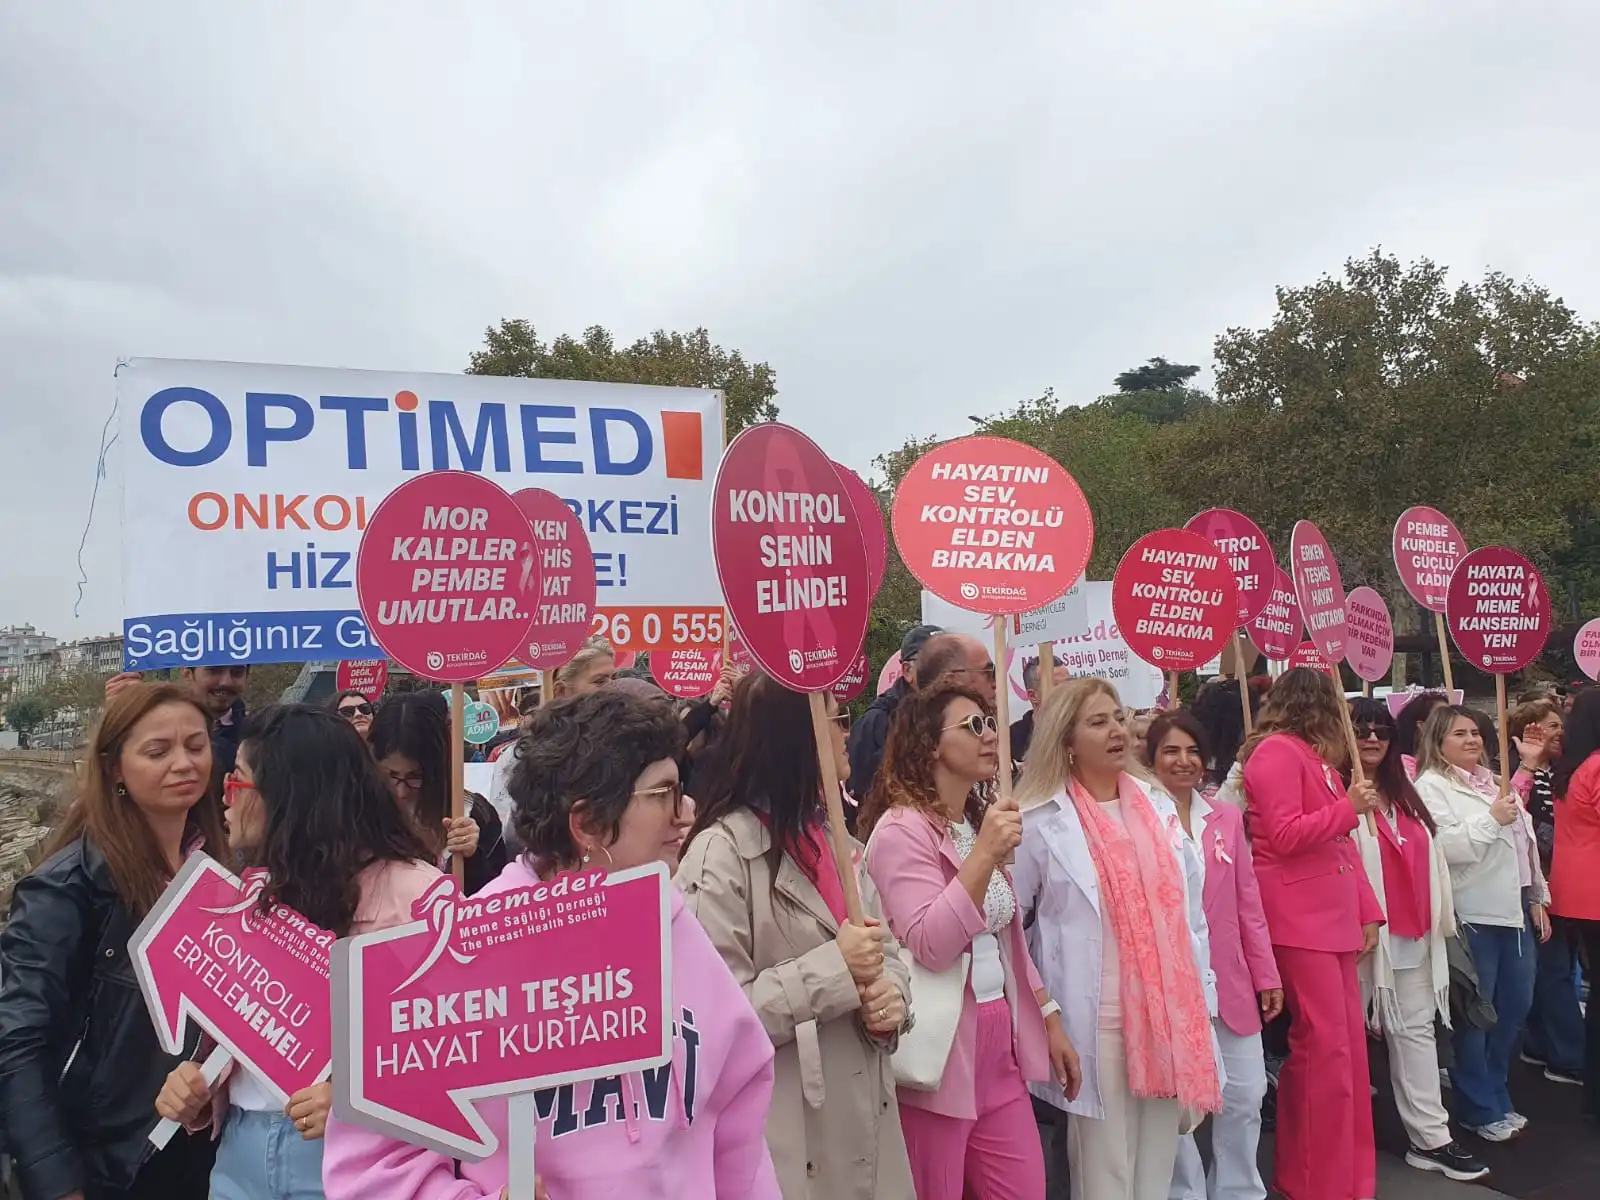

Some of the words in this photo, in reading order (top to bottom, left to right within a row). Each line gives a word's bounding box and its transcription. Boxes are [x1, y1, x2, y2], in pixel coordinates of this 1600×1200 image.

[931, 463, 1050, 484] HAYATINI
[729, 488, 846, 525] KONTROL
[963, 485, 1017, 507] SEV,
[422, 505, 489, 531] MOR
[920, 504, 1064, 528] KONTROLÜ
[951, 528, 1035, 549] ELDEN
[1407, 521, 1449, 538] PEMBE
[391, 536, 517, 562] KALPLER
[759, 524, 833, 568] SENİN
[1300, 544, 1325, 561] ERKEN
[1401, 537, 1459, 558] KURDELE,
[931, 550, 1055, 573] BIRAKMA
[1141, 547, 1218, 570] HAYATINI
[1412, 552, 1454, 573] GÜÇLÜ
[411, 567, 507, 593] PEMBE
[1161, 568, 1196, 588] SEV,
[1467, 565, 1525, 580] HAYATA
[756, 569, 848, 614] ELİNDE!
[1131, 582, 1224, 606] KONTROLÜ
[1311, 588, 1333, 607] HAYAT
[1467, 582, 1525, 600] DOKUN,
[377, 597, 529, 625] UMUTLAR..
[1150, 602, 1204, 622] ELDEN
[1351, 601, 1387, 624] FARKINDA
[1475, 599, 1520, 614] MEME
[642, 612, 662, 646] 0
[672, 612, 722, 644] 555
[1135, 619, 1213, 641] BIRAKMA
[1255, 615, 1294, 636] ELİNDE!
[1310, 608, 1345, 632] KURTARIR
[1459, 612, 1540, 631] KANSERİNİ
[127, 617, 323, 661] Sağlığınız
[1482, 633, 1518, 648] YEN!
[672, 648, 705, 661] DEĞİL,
[1062, 650, 1097, 668] Sağlığı
[1361, 645, 1376, 659] VAR
[664, 671, 712, 681] KAZANIR
[670, 661, 708, 671] YAŞAM
[456, 871, 603, 922] memeder
[459, 920, 499, 939] Meme
[503, 907, 551, 928] Sağlığı
[556, 890, 606, 913] Derneği
[262, 927, 286, 948] Breast
[461, 939, 482, 952] The
[486, 928, 524, 946] Breast
[527, 916, 564, 935] Health
[568, 906, 608, 925] Society
[201, 920, 311, 1027] KONTROLÜ
[173, 934, 315, 1072] ERTELEMEMELİ
[390, 986, 508, 1034] ERKEN
[521, 964, 634, 1015] TEŞHİS
[376, 1029, 483, 1078] HAYAT
[499, 1006, 648, 1058] KURTARIR
